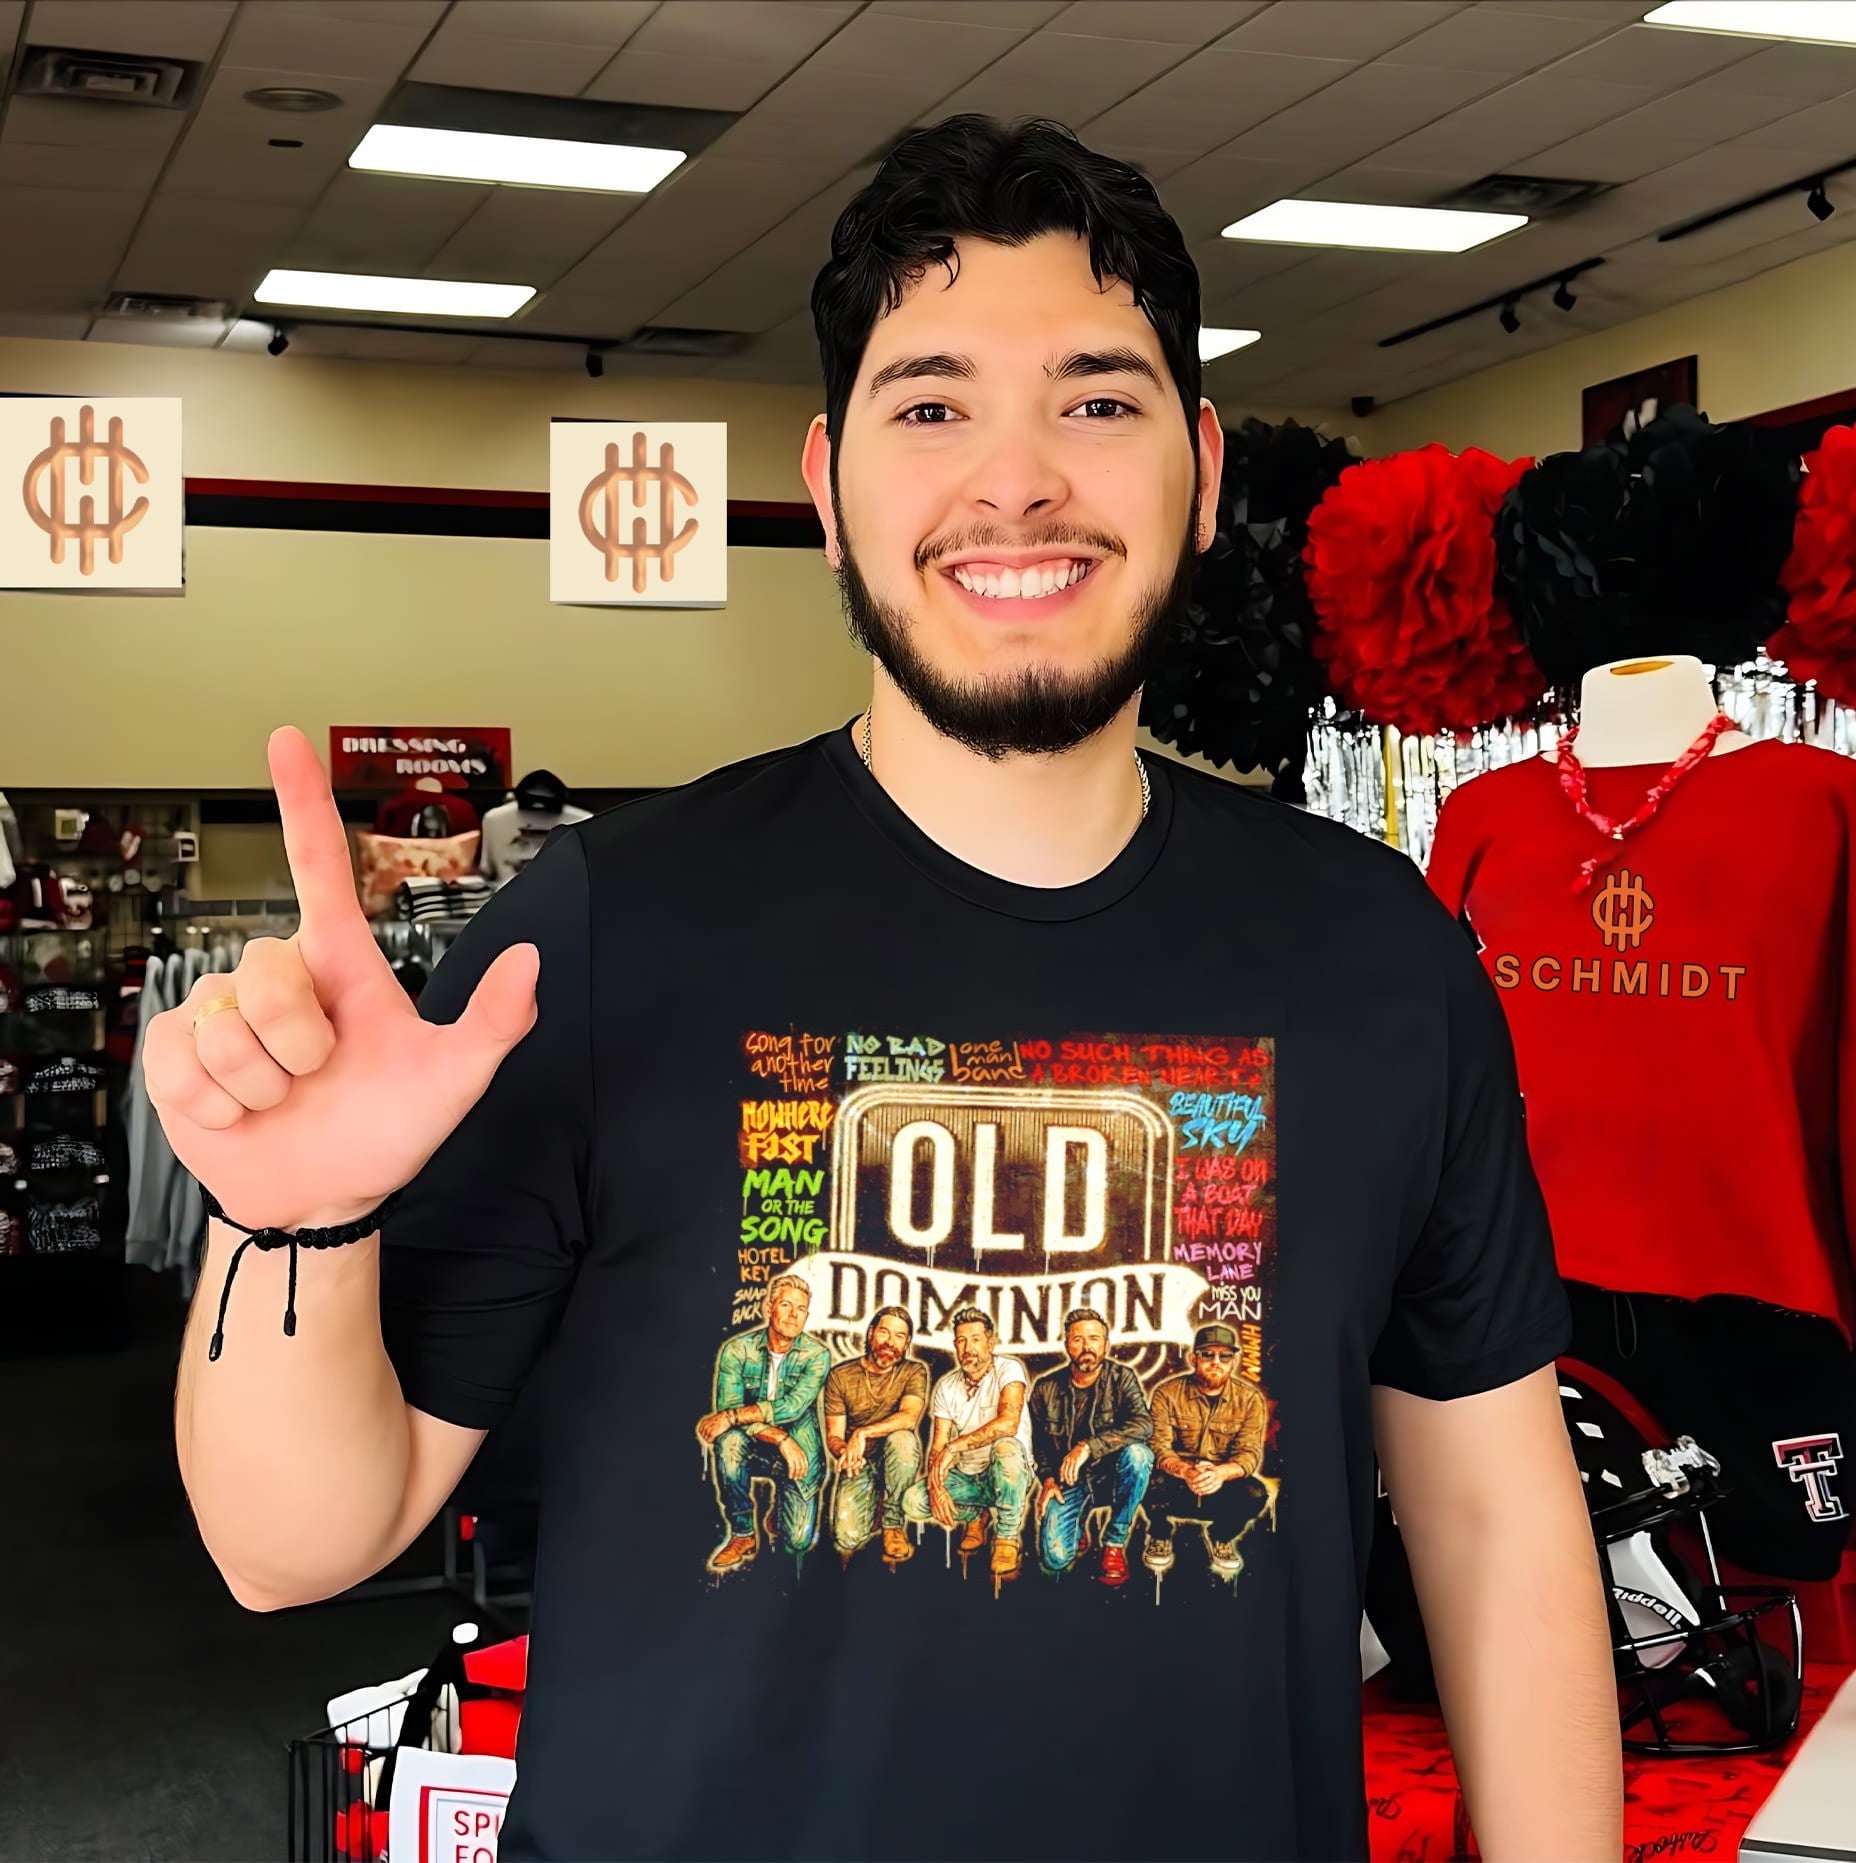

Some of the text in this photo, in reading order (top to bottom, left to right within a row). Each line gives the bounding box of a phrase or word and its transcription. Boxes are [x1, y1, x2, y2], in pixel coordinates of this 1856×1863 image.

[396, 758, 488, 775] ROOMS
[1494, 954, 1747, 1000] SCHMIDT
[745, 1032, 836, 1060] song for
[845, 1034, 946, 1056] NO BAD
[960, 1040, 1003, 1054] one
[1019, 1040, 1269, 1068] NO SUCH THING AS
[751, 1053, 834, 1077] another
[844, 1056, 945, 1083] FEELINGS
[949, 1041, 1027, 1082] band
[966, 1052, 1013, 1066] man
[1031, 1063, 1247, 1087] A BROKEN HEART
[742, 1100, 835, 1132] NOWHERE
[1169, 1091, 1267, 1121] BEAUTIFUL
[744, 1131, 820, 1165] FAST
[1180, 1118, 1259, 1156] SKY
[1173, 1157, 1191, 1181] I
[1194, 1155, 1237, 1182] WAS
[742, 1168, 825, 1199] MAN
[889, 1120, 1108, 1254] OLD
[1182, 1181, 1258, 1205] A BOAT
[761, 1199, 815, 1216] OR THE
[740, 1215, 829, 1248] SONG
[1173, 1206, 1263, 1240] THAT DAY
[738, 1247, 791, 1265] HOTEL
[1173, 1241, 1263, 1265] MEMORY
[740, 1265, 770, 1283] KEY
[1206, 1264, 1255, 1282] LANE
[732, 1286, 767, 1305] SNAP
[828, 1261, 1166, 1345] DOMINION
[731, 1301, 763, 1325] BACK
[1199, 1301, 1262, 1321] MAN
